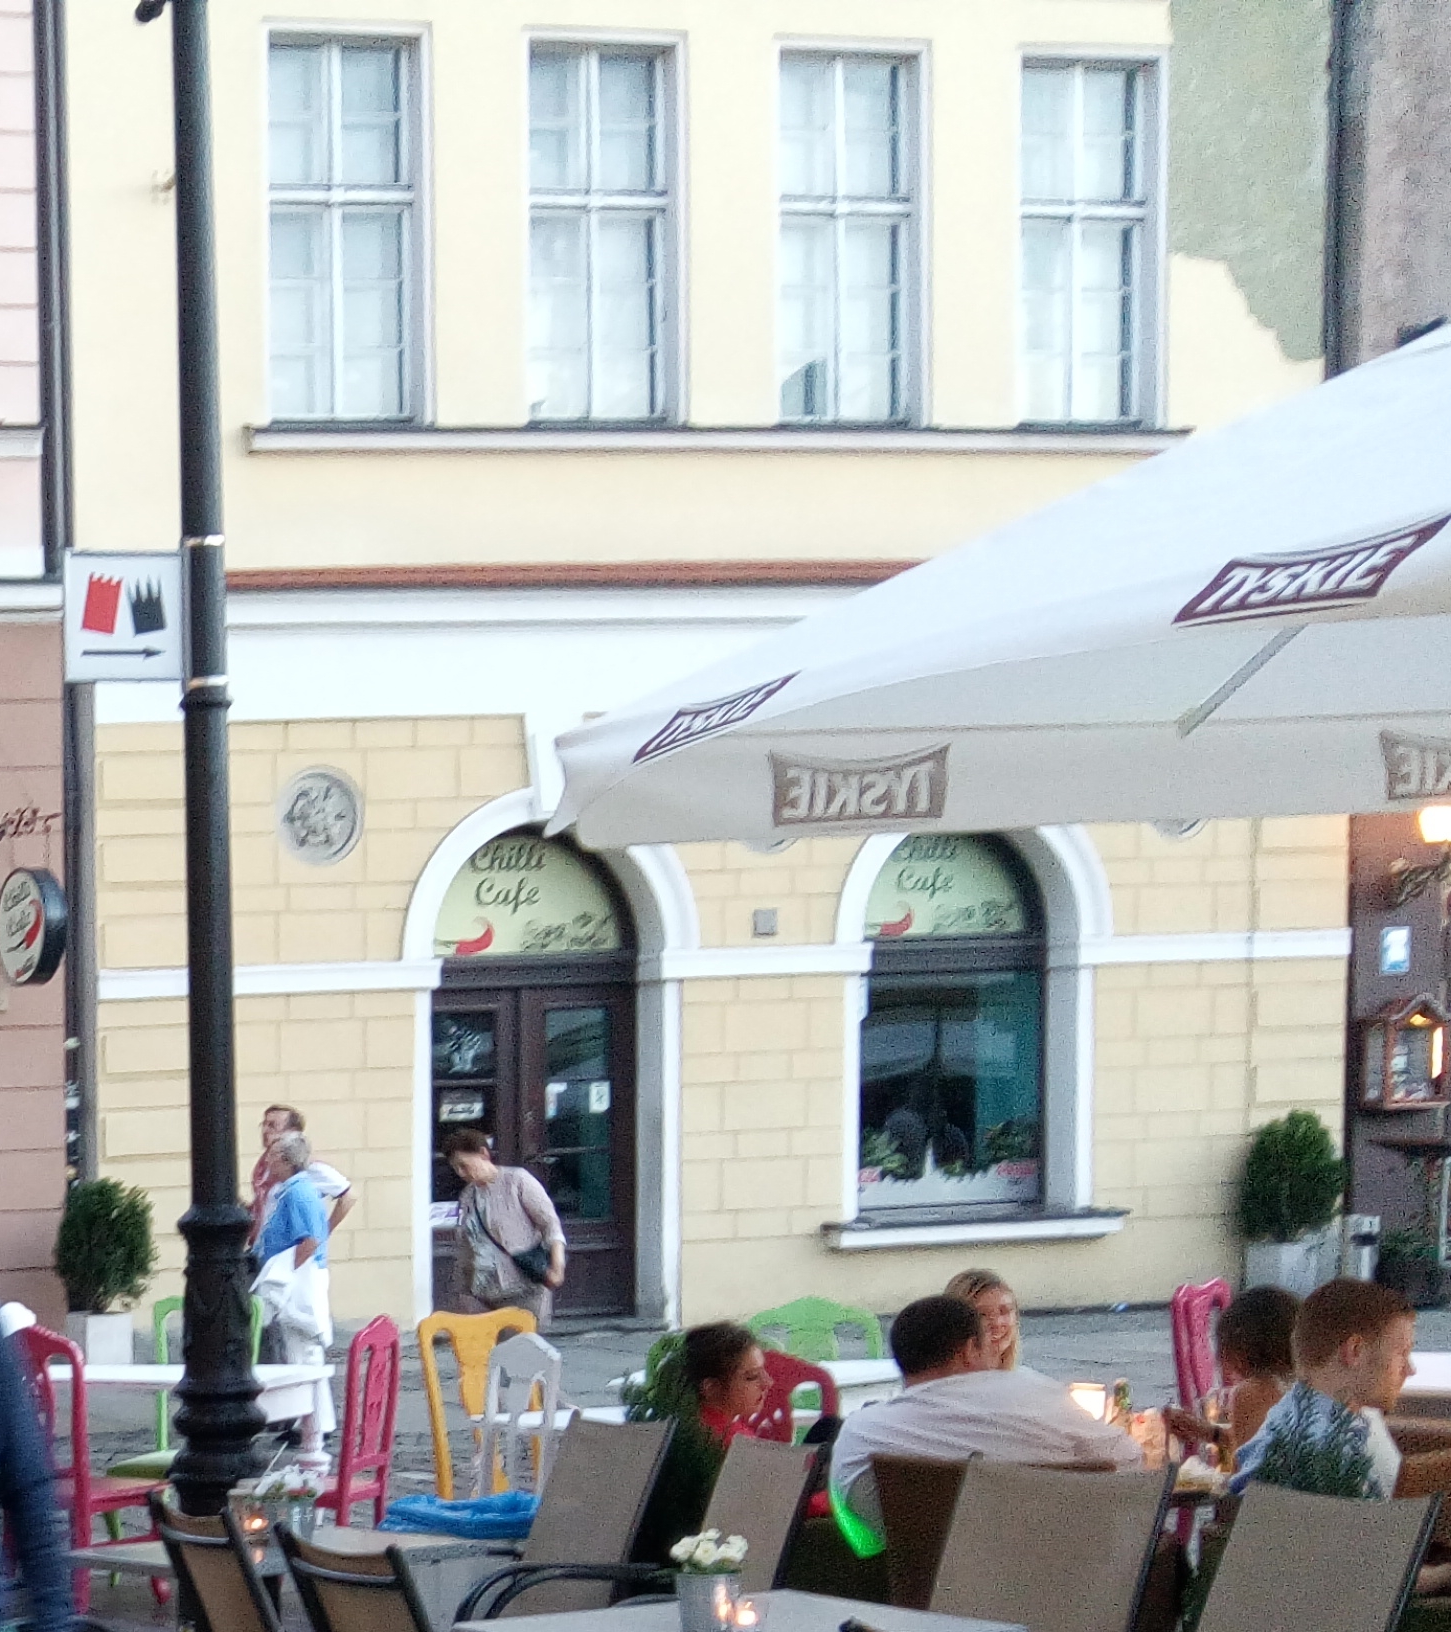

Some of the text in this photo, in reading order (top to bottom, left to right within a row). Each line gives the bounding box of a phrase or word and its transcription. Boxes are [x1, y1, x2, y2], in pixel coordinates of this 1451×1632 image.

[1194, 532, 1419, 613] TYSKIE
[471, 842, 547, 873] Chilli
[475, 876, 542, 915] Cafe
